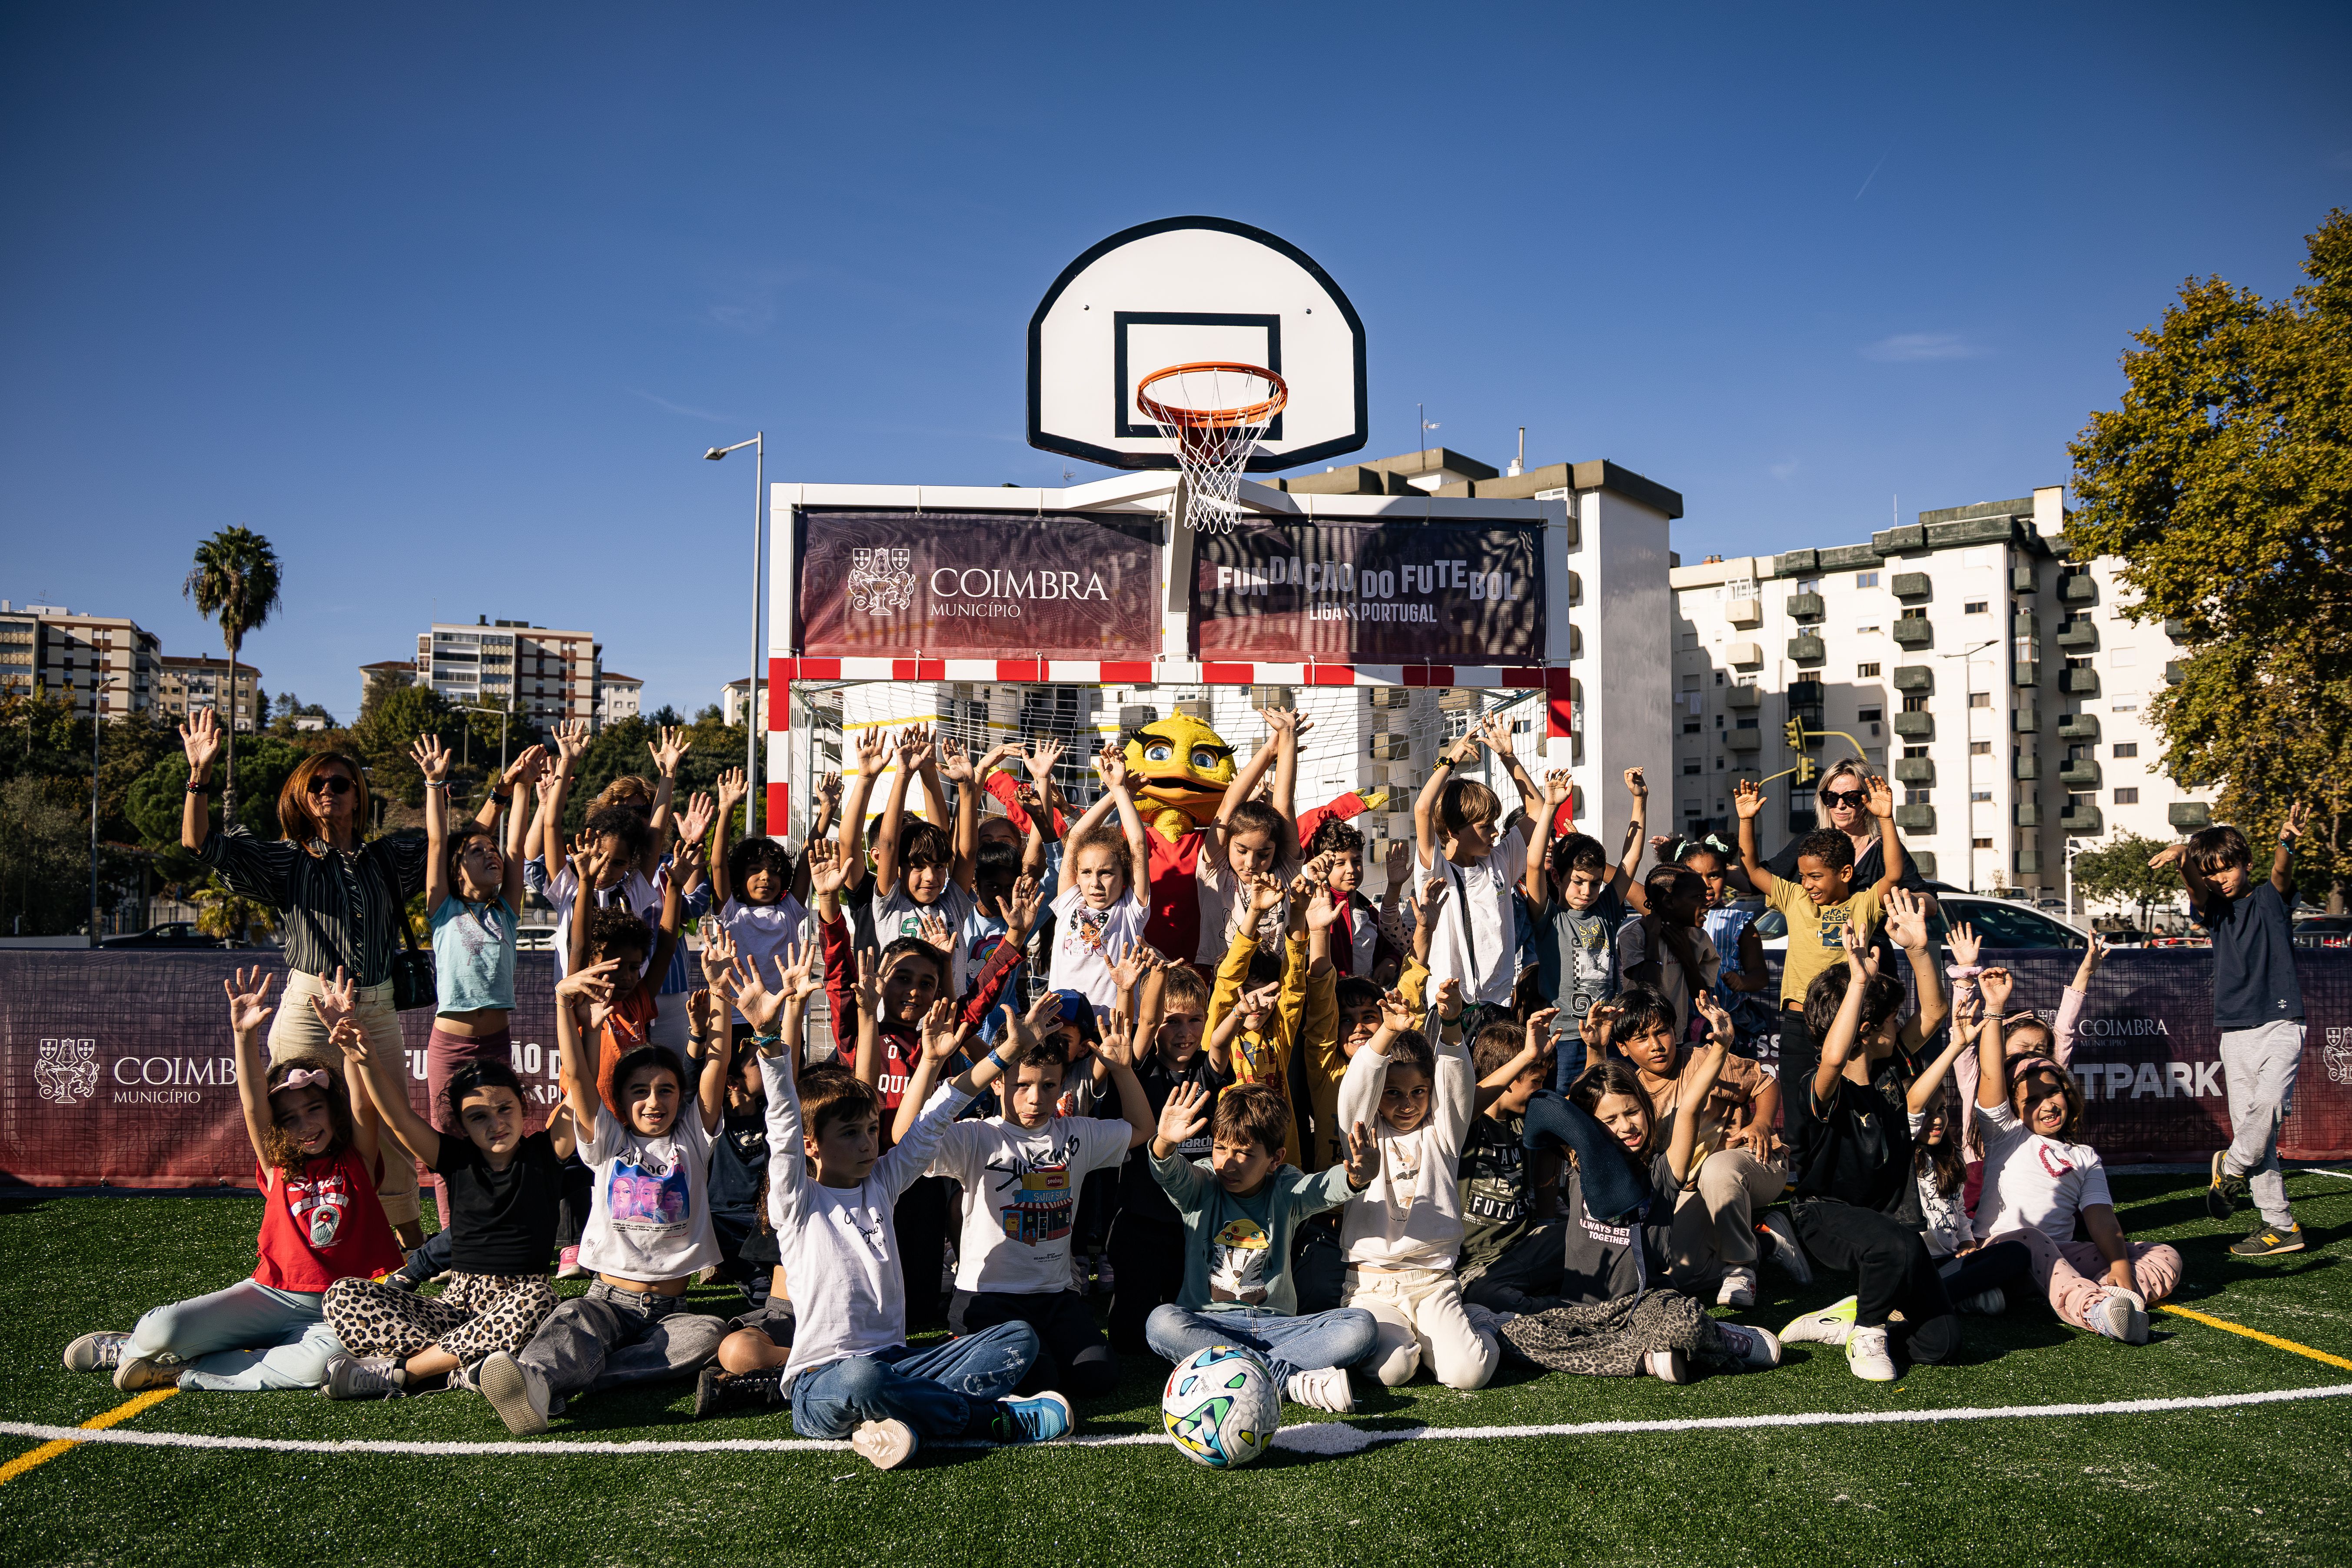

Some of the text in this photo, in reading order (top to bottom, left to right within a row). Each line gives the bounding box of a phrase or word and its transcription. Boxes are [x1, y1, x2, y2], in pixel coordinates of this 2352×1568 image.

[930, 567, 1110, 601] COIMBRA
[1217, 556, 1519, 601] FUNDAÇÃO DO FUTEBOL
[930, 602, 1021, 618] MUNICÍPIO
[1309, 602, 1438, 623] LIGA PORTUGAL
[2079, 1019, 2169, 1036] COIMBRA
[114, 1057, 237, 1086] COIMB
[113, 1089, 201, 1103] MUNICÍPIO
[1579, 1218, 1611, 1233] ALWAYS
[1589, 1231, 1630, 1246] TOGETHER
